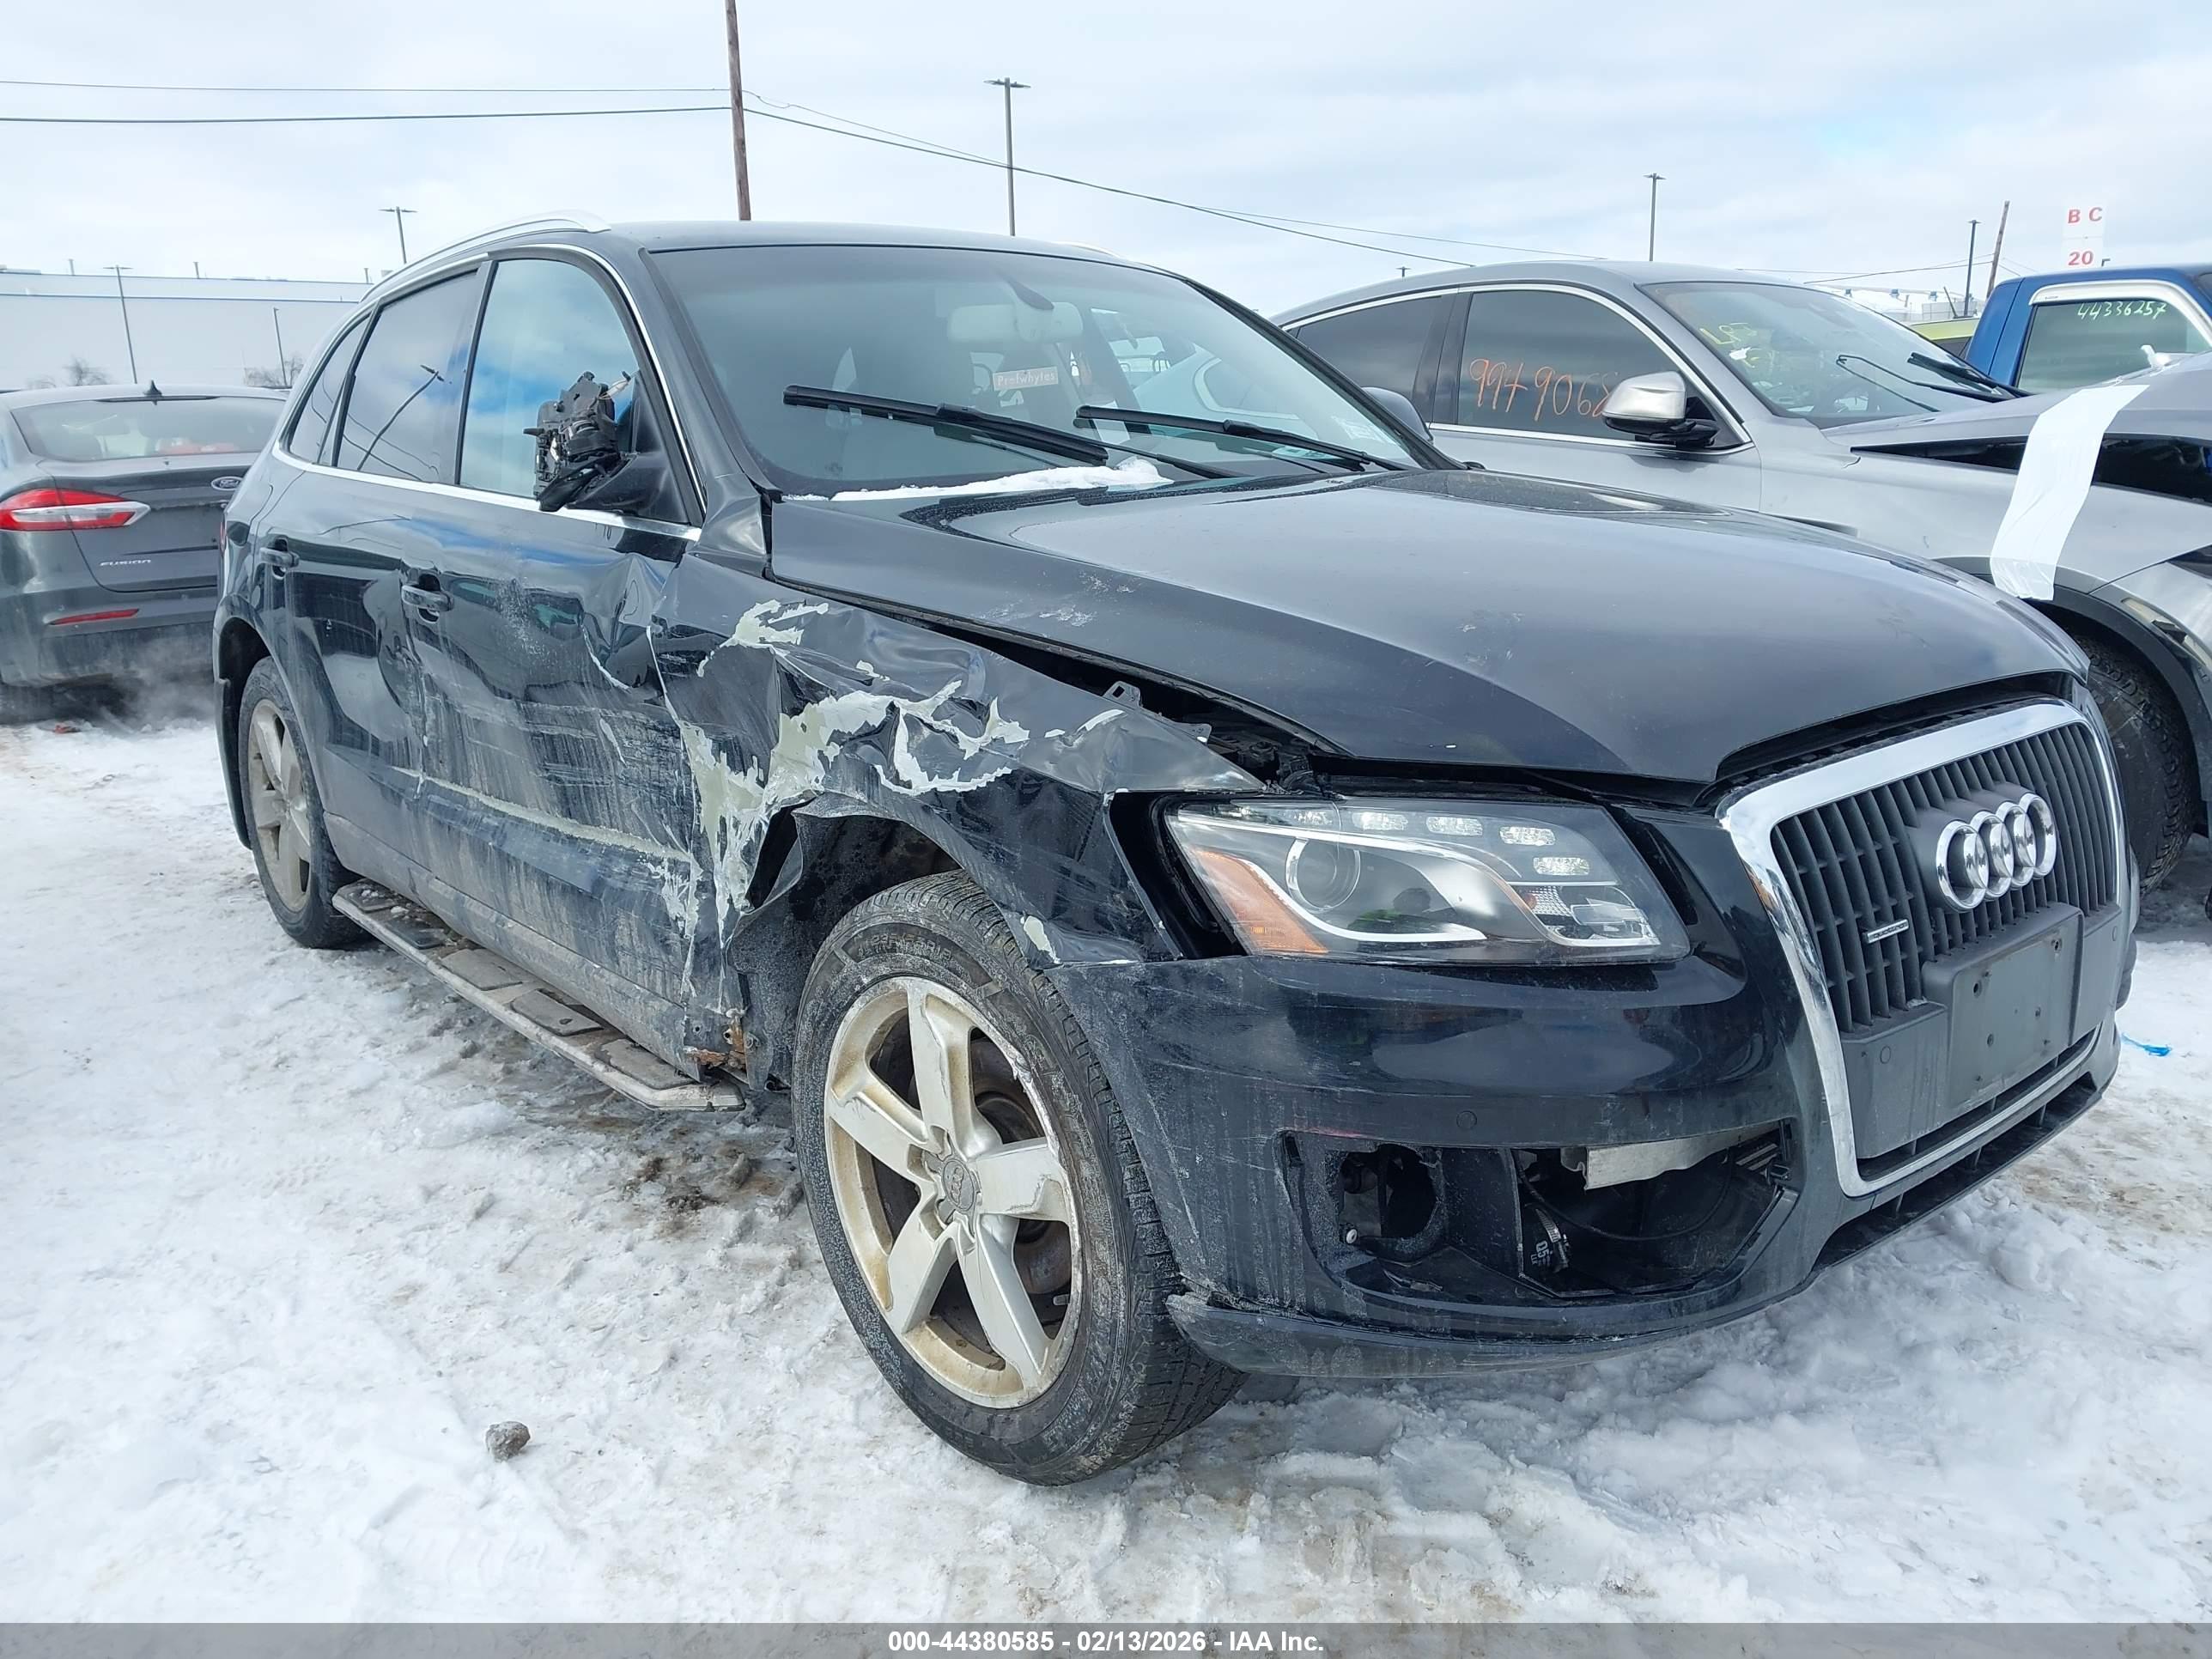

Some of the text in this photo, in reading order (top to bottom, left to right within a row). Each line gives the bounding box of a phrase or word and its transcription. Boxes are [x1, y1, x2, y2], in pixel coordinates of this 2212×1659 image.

[2068, 207, 2103, 224] B C
[2068, 251, 2094, 266] 20
[2077, 301, 2166, 320] 44336257
